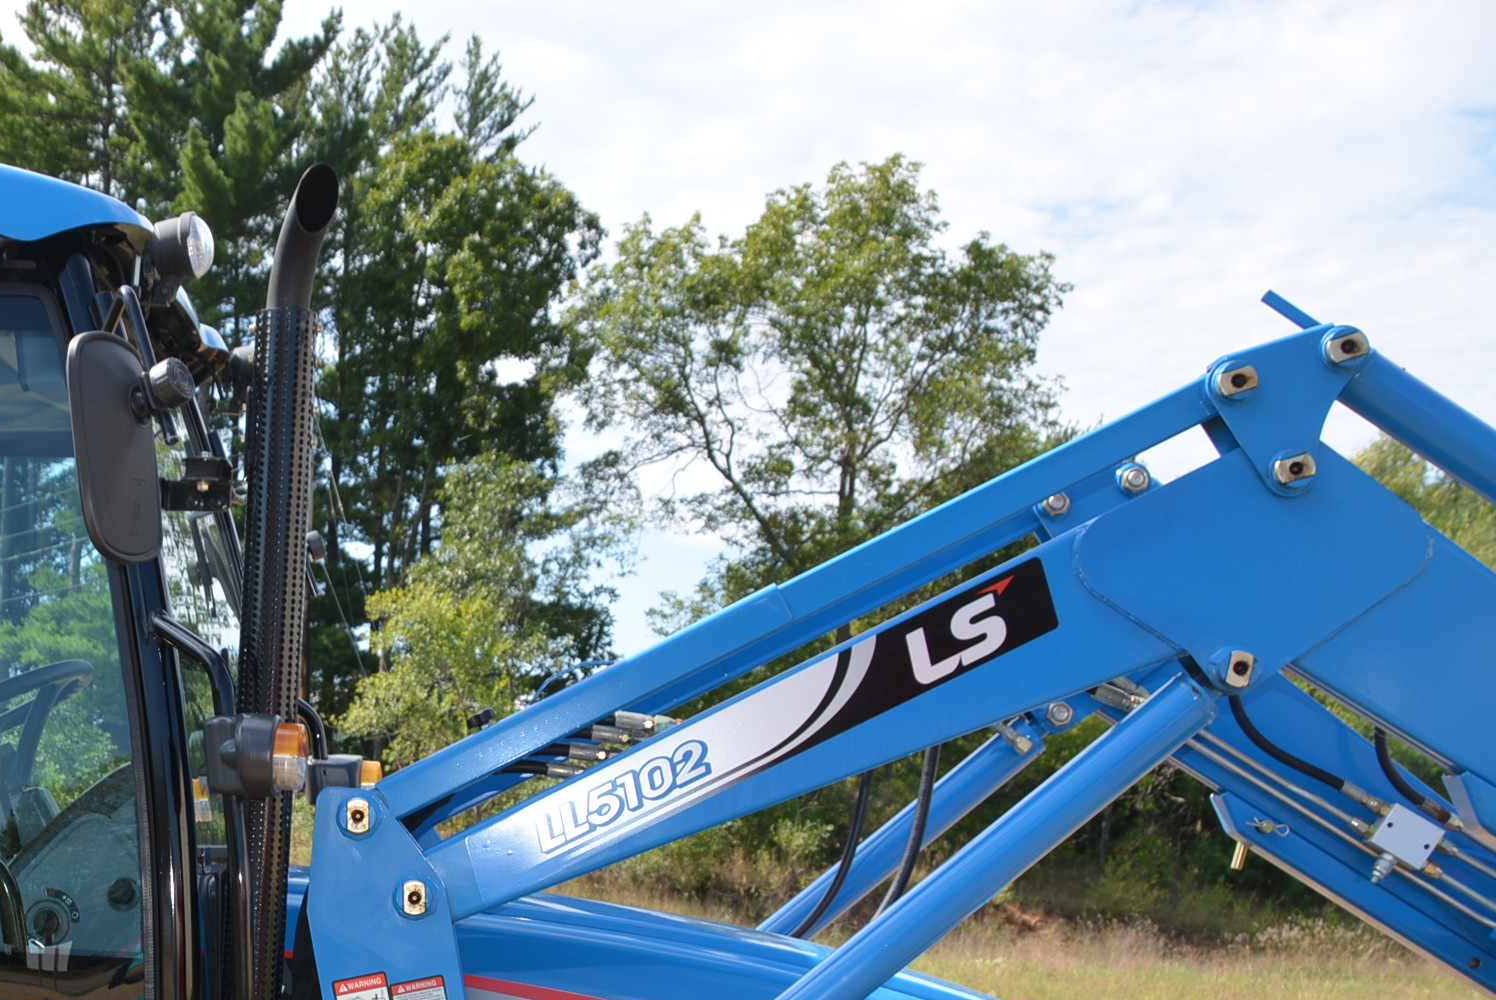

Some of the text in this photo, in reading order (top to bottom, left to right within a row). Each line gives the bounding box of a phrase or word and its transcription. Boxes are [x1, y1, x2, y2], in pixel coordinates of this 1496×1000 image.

[905, 592, 1007, 685] LS
[535, 739, 712, 855] LL5102
[347, 976, 383, 991] WARNING
[405, 979, 438, 992] WARNING
